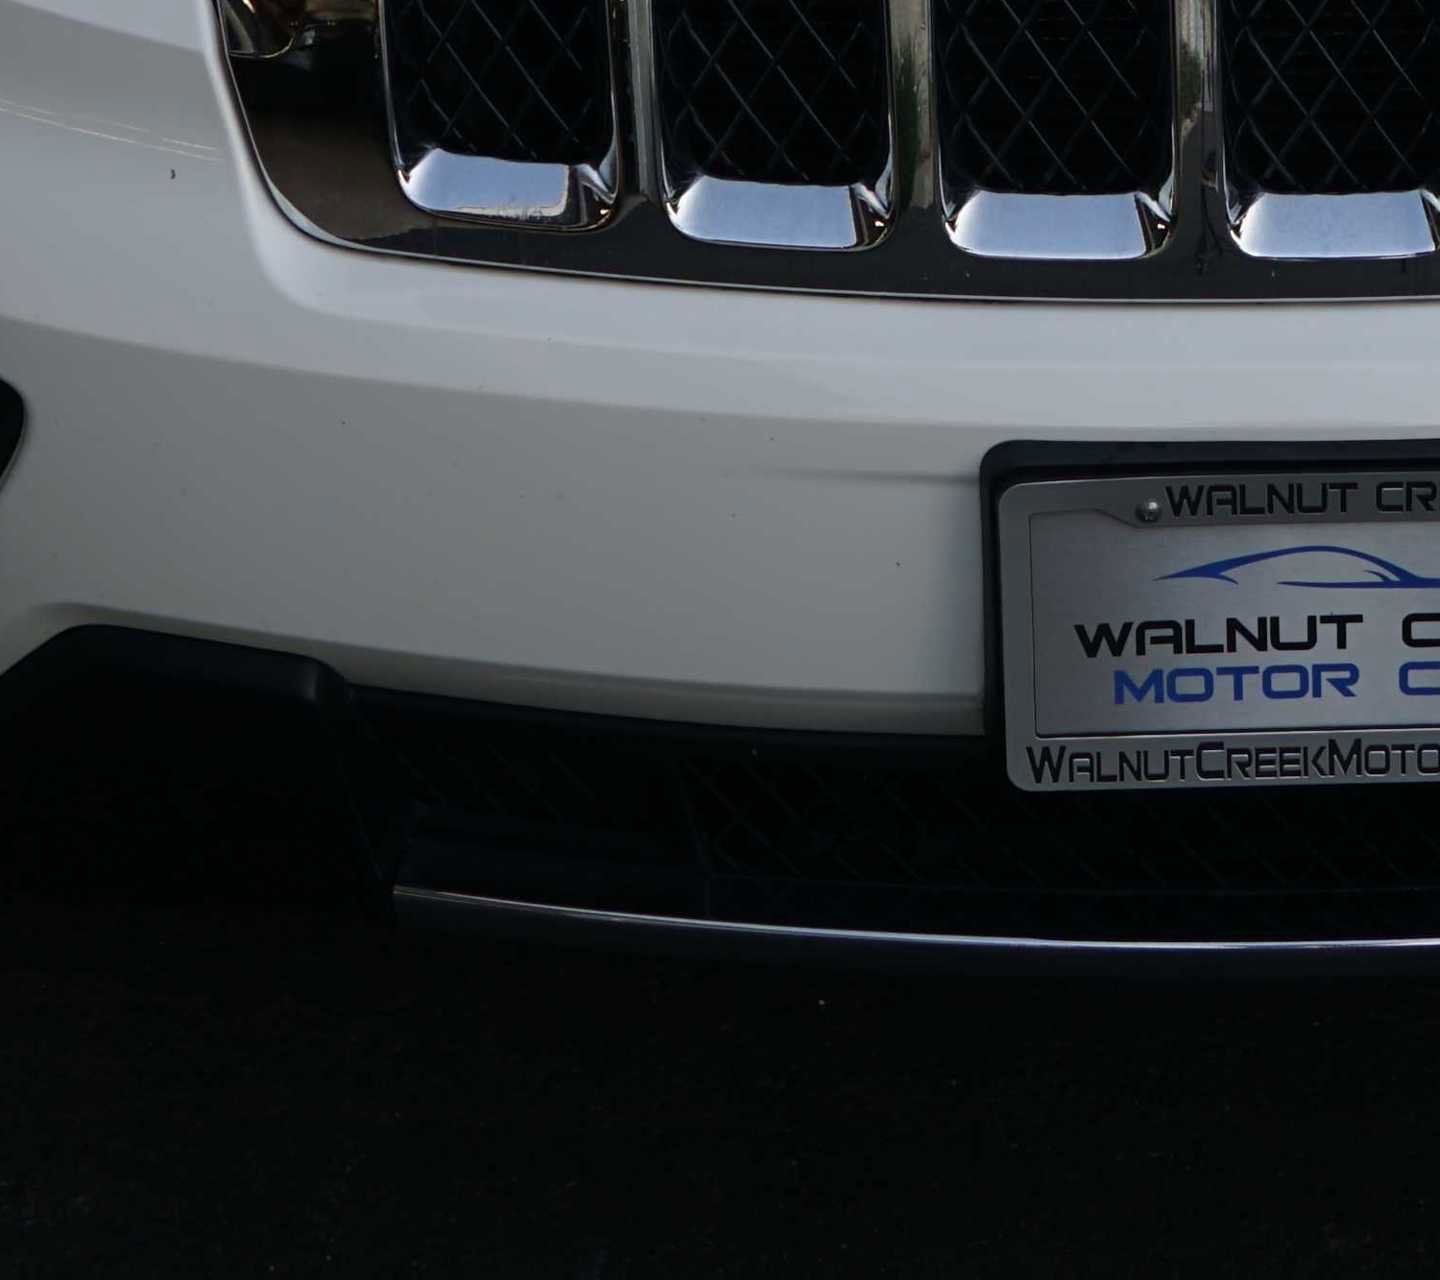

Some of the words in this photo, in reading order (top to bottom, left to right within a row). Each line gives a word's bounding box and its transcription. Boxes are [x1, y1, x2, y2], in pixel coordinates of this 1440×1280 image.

[1165, 482, 1359, 517] WALNUT
[1073, 614, 1364, 659] WALNUT
[1113, 662, 1361, 705] MOTOR
